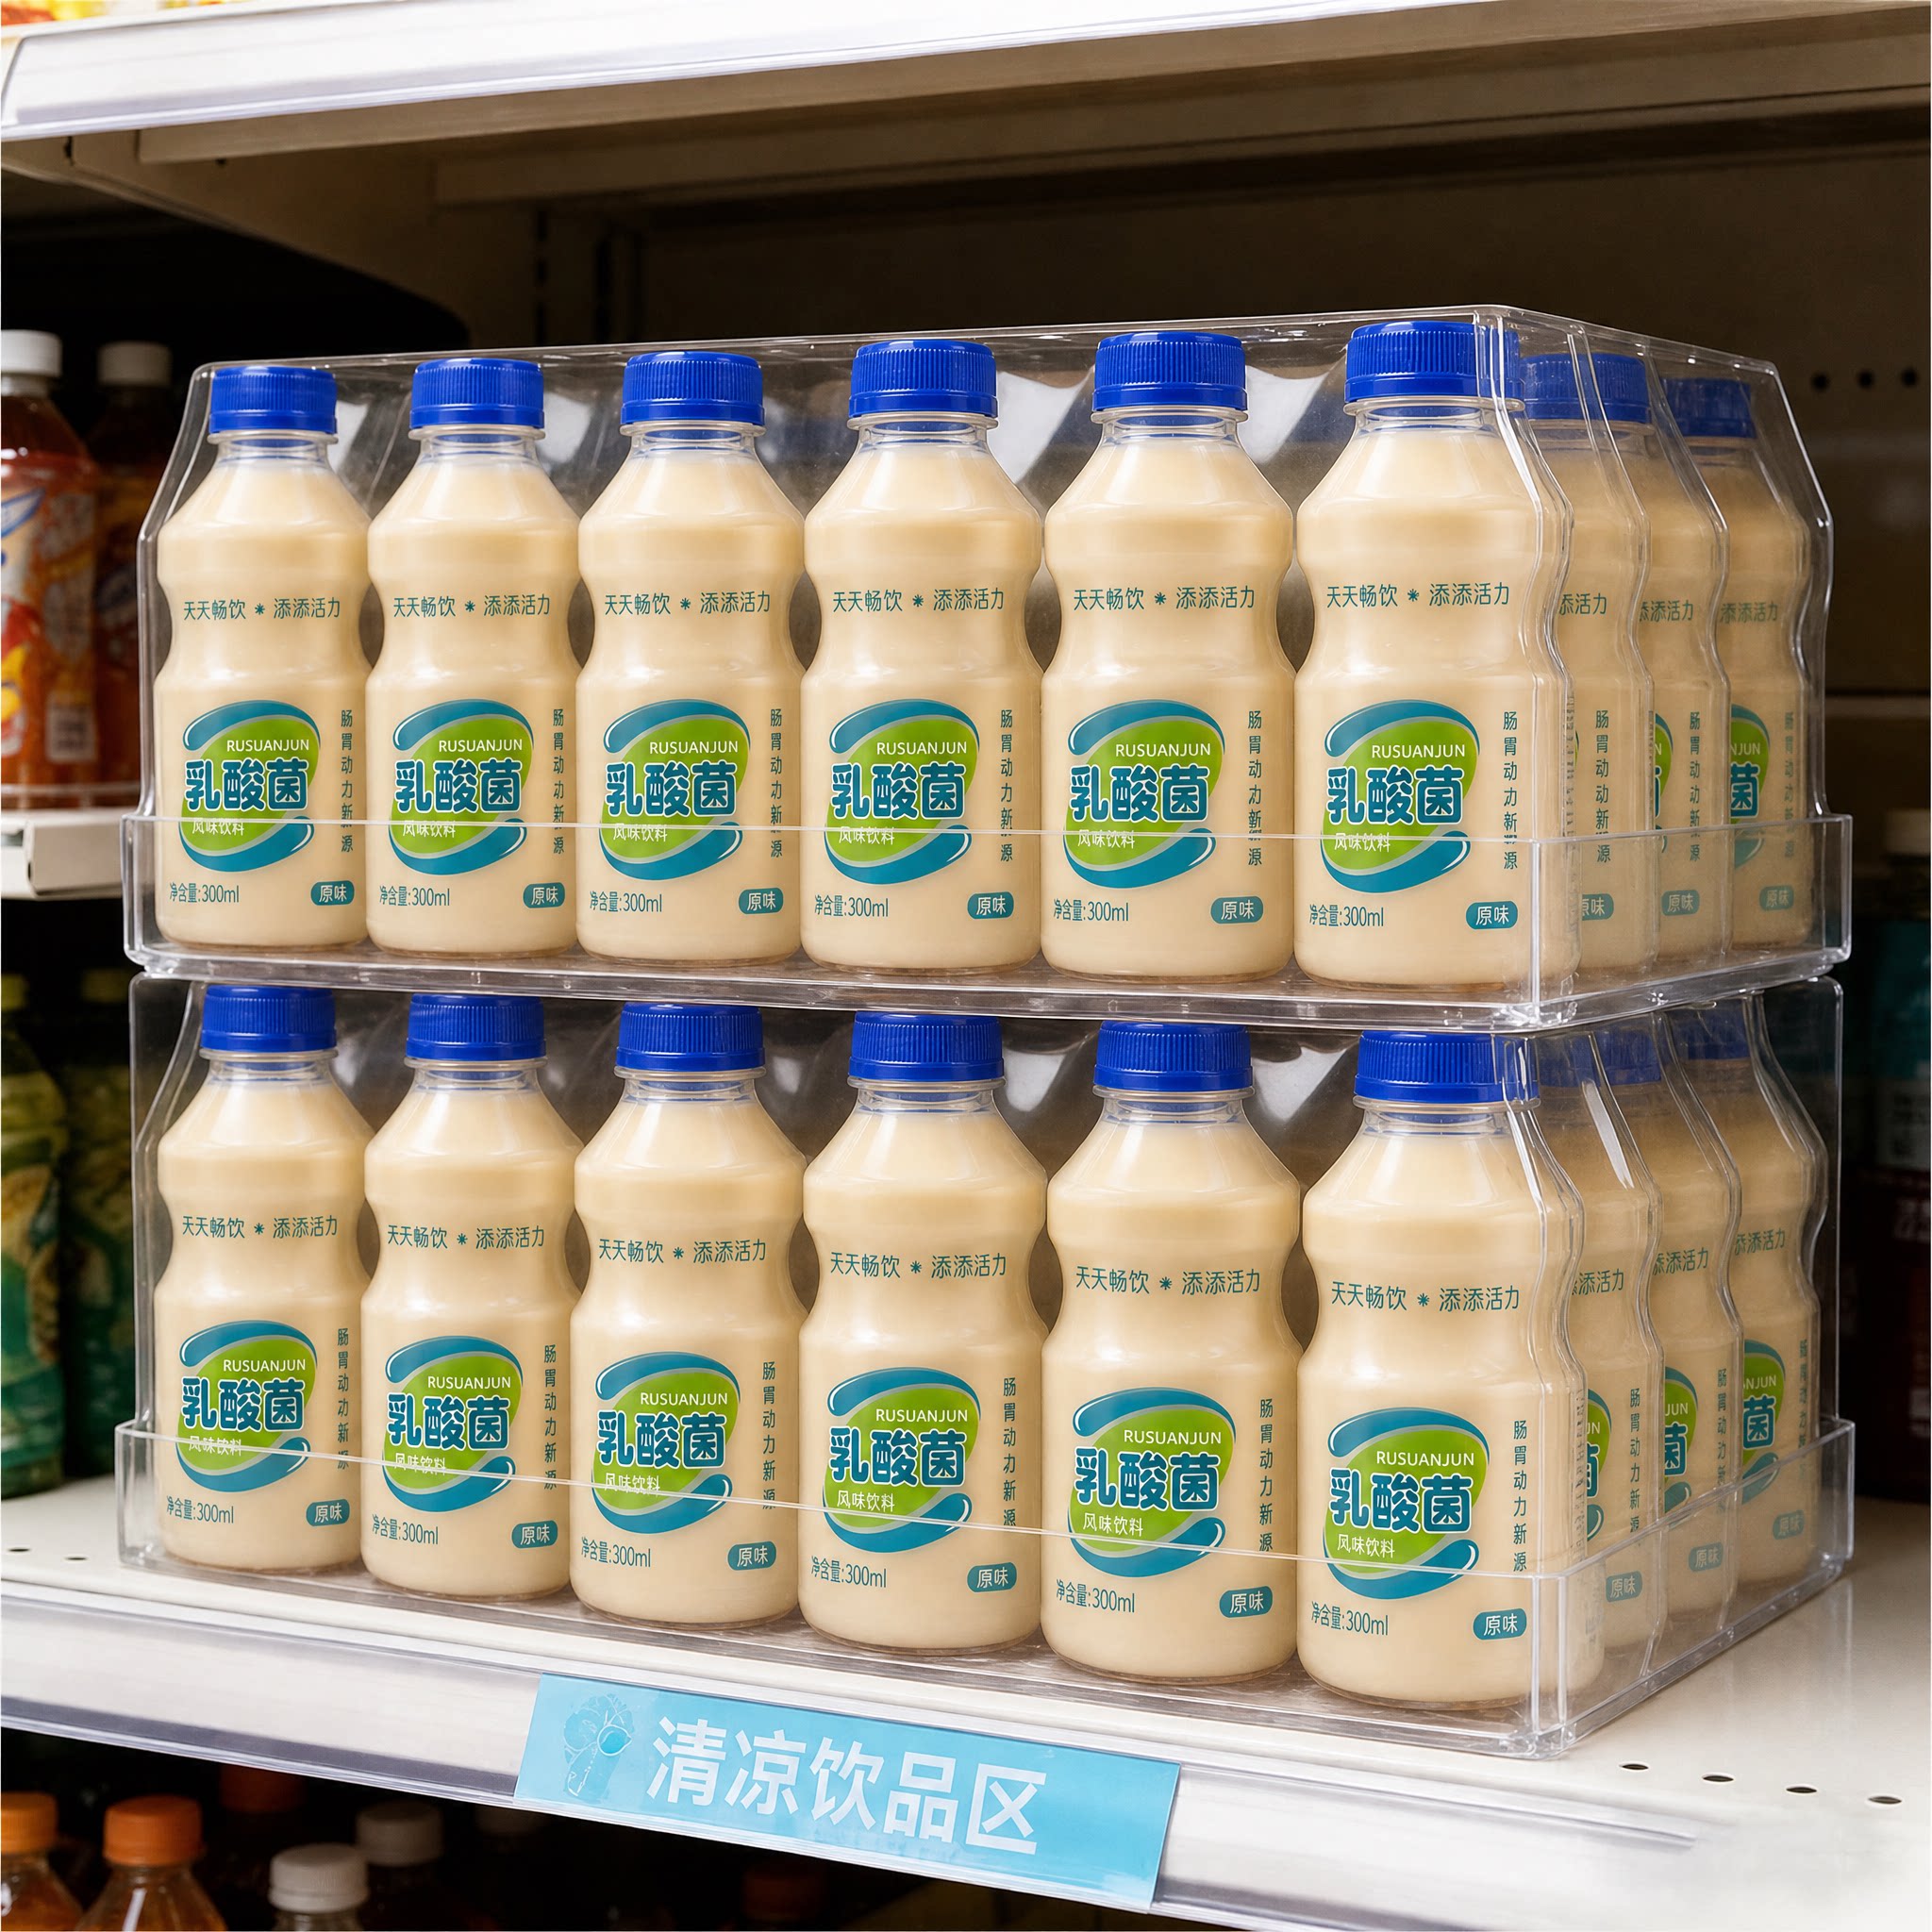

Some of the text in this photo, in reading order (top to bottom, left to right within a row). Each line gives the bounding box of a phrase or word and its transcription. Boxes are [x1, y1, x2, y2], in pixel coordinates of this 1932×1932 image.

[393, 594, 550, 618] 天天畅饮 添添活力
[605, 591, 771, 615] 天天畅饮 添添活力
[833, 589, 1004, 612] 天天畅饮 添添活力
[1074, 586, 1255, 610] 天天畅饮 添添活力
[1326, 582, 1509, 608] 天天畅饮 添添活力
[1560, 593, 1607, 615] 添活力
[184, 598, 341, 620] 天天畅饮 添添活力
[226, 740, 309, 753] RUSUANJUN
[439, 740, 522, 753] RUSUANJUN
[649, 741, 738, 755] RUSUANJUN
[876, 741, 967, 755] RUSUANJUN
[1115, 743, 1211, 757] RUSUANJUN
[1372, 744, 1465, 758] RUSUANJUN
[185, 757, 308, 811] 乳酸菌
[394, 758, 521, 813] 乳酸菌
[606, 760, 737, 818] 乳酸菌
[832, 761, 965, 820] 乳酸菌
[1070, 764, 1210, 823] 乳酸菌
[1327, 765, 1464, 825] 乳酸菌
[192, 817, 244, 836] 风味饮料
[402, 821, 456, 838] 风味饮料
[613, 824, 667, 842] 风味饮料
[839, 826, 894, 844] 风味饮料
[1077, 829, 1135, 849] 风味饮料
[1334, 833, 1391, 853] 风味饮料
[170, 883, 240, 903] 净含量:300ml
[319, 885, 347, 902] 原味
[379, 886, 450, 907] 净含量:300ml
[531, 887, 558, 905] 原味
[590, 891, 662, 913] 净含量:300ml
[746, 892, 775, 911] 原味
[1668, 894, 1692, 912] 原味
[815, 895, 889, 918] 净含量:300ml
[976, 896, 1006, 915] 原味
[1054, 899, 1129, 922] 净含量:300ml
[1221, 900, 1254, 920] 原味
[1309, 904, 1384, 927] 净含量:300ml
[1475, 905, 1509, 925] 原味
[183, 1215, 337, 1239] 天天畅饮 添添活力
[388, 1225, 544, 1249] 天天畅饮 添添活力
[599, 1239, 766, 1263] 天天畅饮 添添活力
[830, 1252, 1007, 1279] 天天畅饮 添添活力
[1076, 1266, 1260, 1296] 天天畅饮 添添活力
[1572, 1269, 1624, 1295] 添活力
[1331, 1282, 1519, 1312] 天天畅饮 添添活力
[223, 1358, 306, 1373] RUSUANJUN
[428, 1375, 511, 1390] RUSUANJUN
[182, 1377, 305, 1432] 乳酸菌
[640, 1392, 727, 1406] RUSUANJUN
[387, 1393, 510, 1451] 乳酸菌
[875, 1408, 968, 1423] RUSUANJUN
[189, 1437, 242, 1456] 风味饮料
[597, 1411, 725, 1469] 乳酸菌
[1124, 1429, 1222, 1444] RUSUANJUN
[394, 1453, 446, 1475] 风味饮料
[830, 1426, 967, 1488] 乳酸菌
[1376, 1451, 1474, 1466] RUSUANJUN
[605, 1473, 660, 1493] 风味饮料
[1075, 1447, 1220, 1512] 乳酸菌
[1259, 1399, 1273, 1552] 肠胃动力新源
[837, 1490, 894, 1511] 风味饮料
[1330, 1468, 1473, 1534] 乳酸菌
[1513, 1421, 1527, 1572] 肠胃动力新源
[166, 1495, 233, 1524] 净含量:300ml
[314, 1503, 342, 1522] 原味
[373, 1515, 439, 1545] 净含量:300ml
[521, 1524, 550, 1543] 原味
[1083, 1512, 1143, 1537] 风味饮料
[581, 1538, 650, 1568] 净含量:300ml
[737, 1546, 768, 1566] 原味
[1338, 1535, 1394, 1558] 风味饮料
[1695, 1547, 1719, 1568] 原味
[811, 1556, 886, 1588] 净含量:300ml
[977, 1567, 1008, 1587] 原味
[1057, 1579, 1135, 1613] 净含量:300ml
[1610, 1576, 1635, 1597] 原味
[1230, 1591, 1264, 1612] 原味
[1311, 1601, 1388, 1636] 净含量:300ml
[1483, 1613, 1518, 1635] 原味
[646, 1716, 1046, 1855] 清凉饮品区
